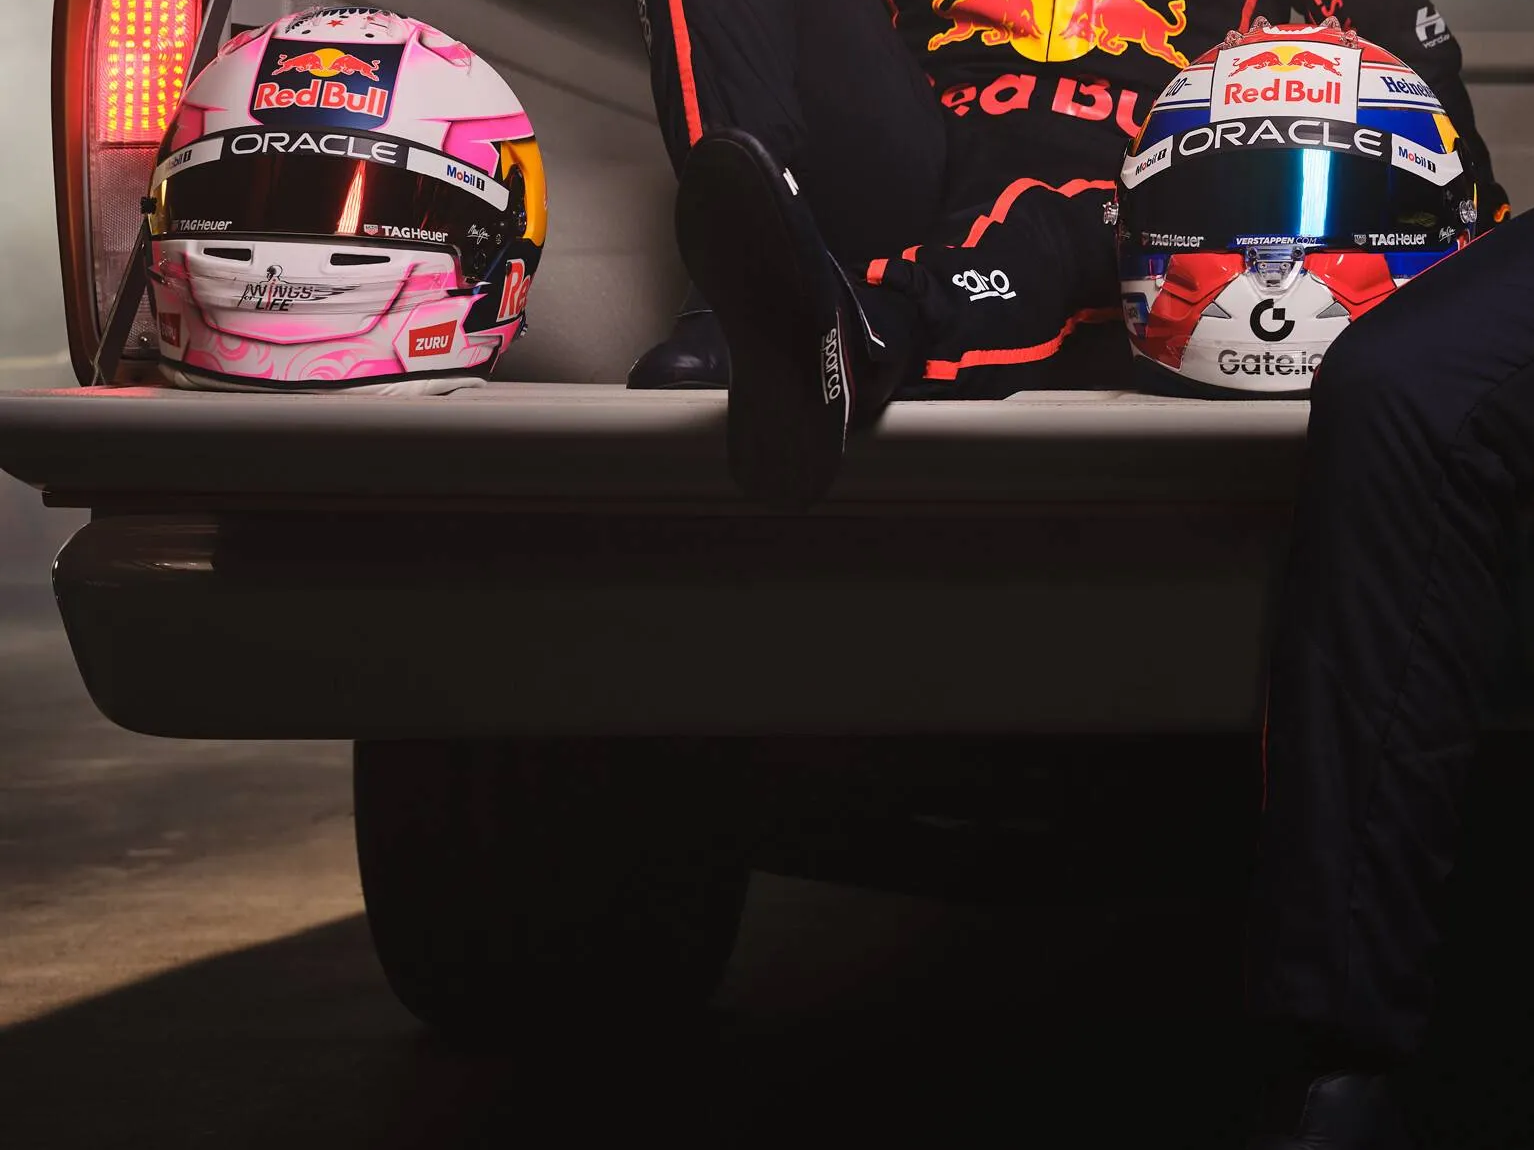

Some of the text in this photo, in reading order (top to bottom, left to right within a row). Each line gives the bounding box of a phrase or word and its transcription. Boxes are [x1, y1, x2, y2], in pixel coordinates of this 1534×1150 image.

[253, 80, 388, 118] Red Bull
[1224, 79, 1341, 105] Red Bull
[230, 132, 399, 163] ORACLE
[1178, 119, 1383, 157] ORACLE
[1136, 151, 1158, 176] Mobil
[1398, 146, 1427, 167] Mobil
[446, 164, 476, 187] Mobil
[414, 335, 450, 352] ZURU
[821, 327, 841, 400] sparco
